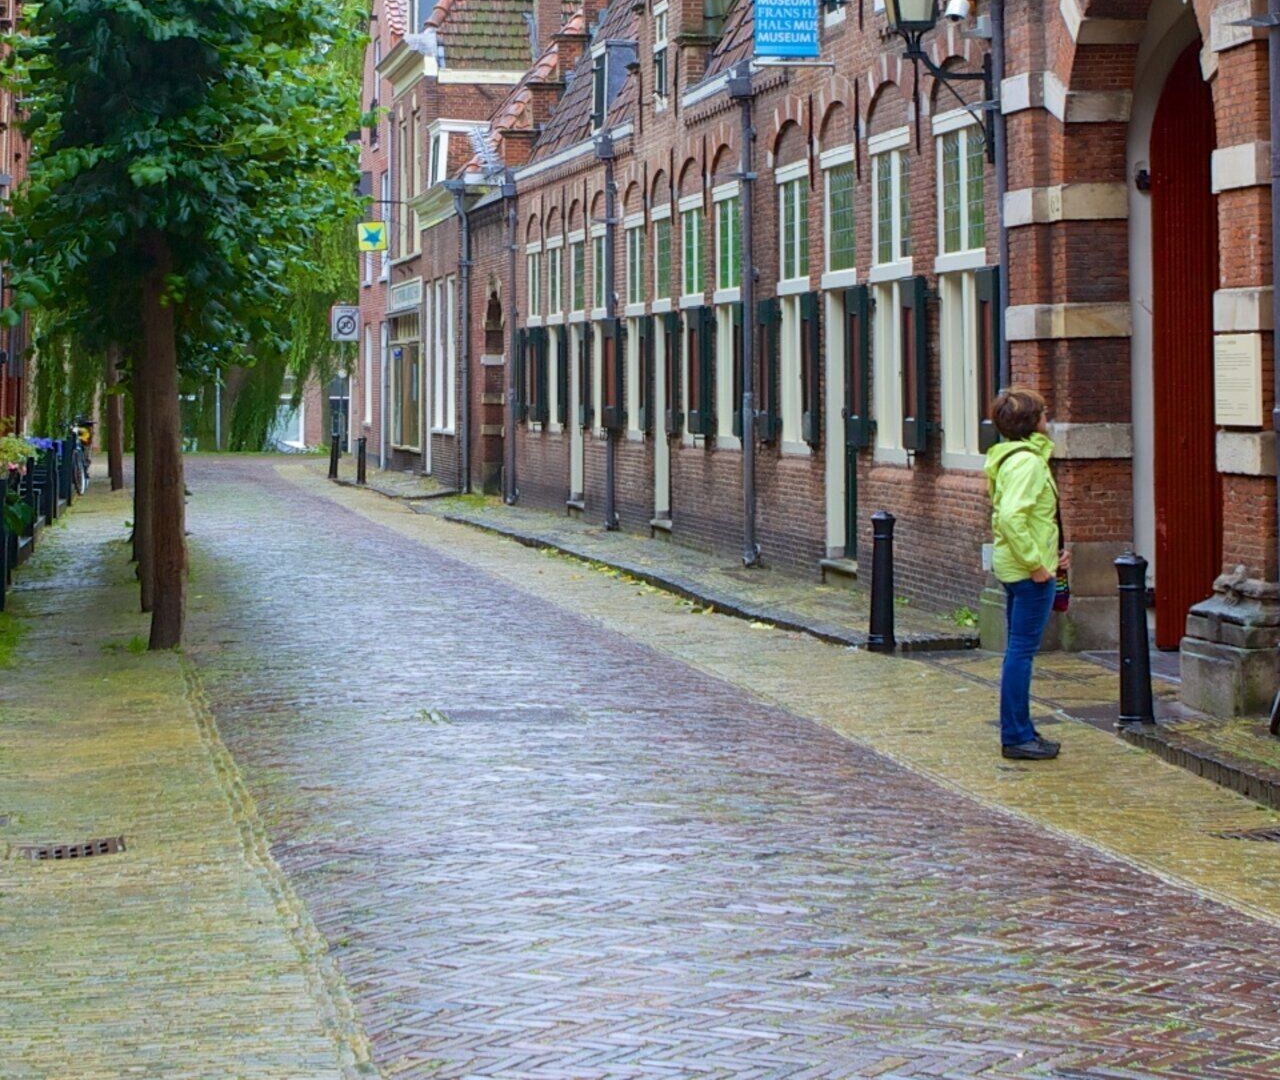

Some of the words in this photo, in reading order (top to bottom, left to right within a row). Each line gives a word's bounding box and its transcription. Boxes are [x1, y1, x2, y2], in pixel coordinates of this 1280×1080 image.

[758, 7, 800, 18] FRANS
[758, 20, 791, 30] HALS
[758, 32, 811, 42] MUSEUM
